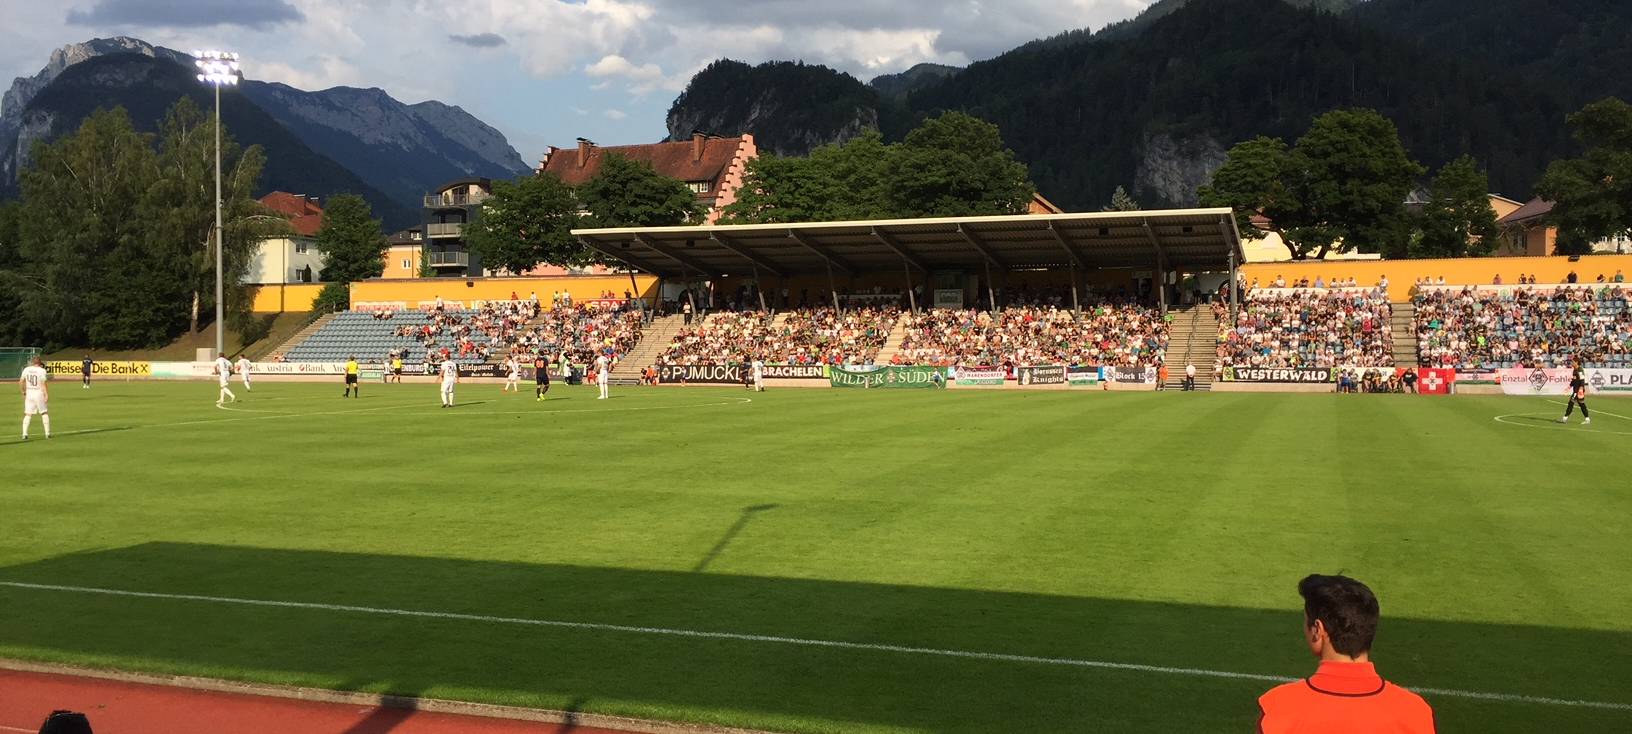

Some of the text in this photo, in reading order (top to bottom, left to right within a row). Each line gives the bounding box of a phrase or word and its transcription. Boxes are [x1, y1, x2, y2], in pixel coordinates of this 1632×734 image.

[92, 363, 110, 373] Die
[111, 362, 139, 374] Bank
[305, 364, 326, 372] Bank
[762, 366, 823, 377] BRACHELEN
[26, 374, 38, 387] 40
[1237, 369, 1328, 381] WESTERWALD
[1502, 375, 1528, 383] Enztal
